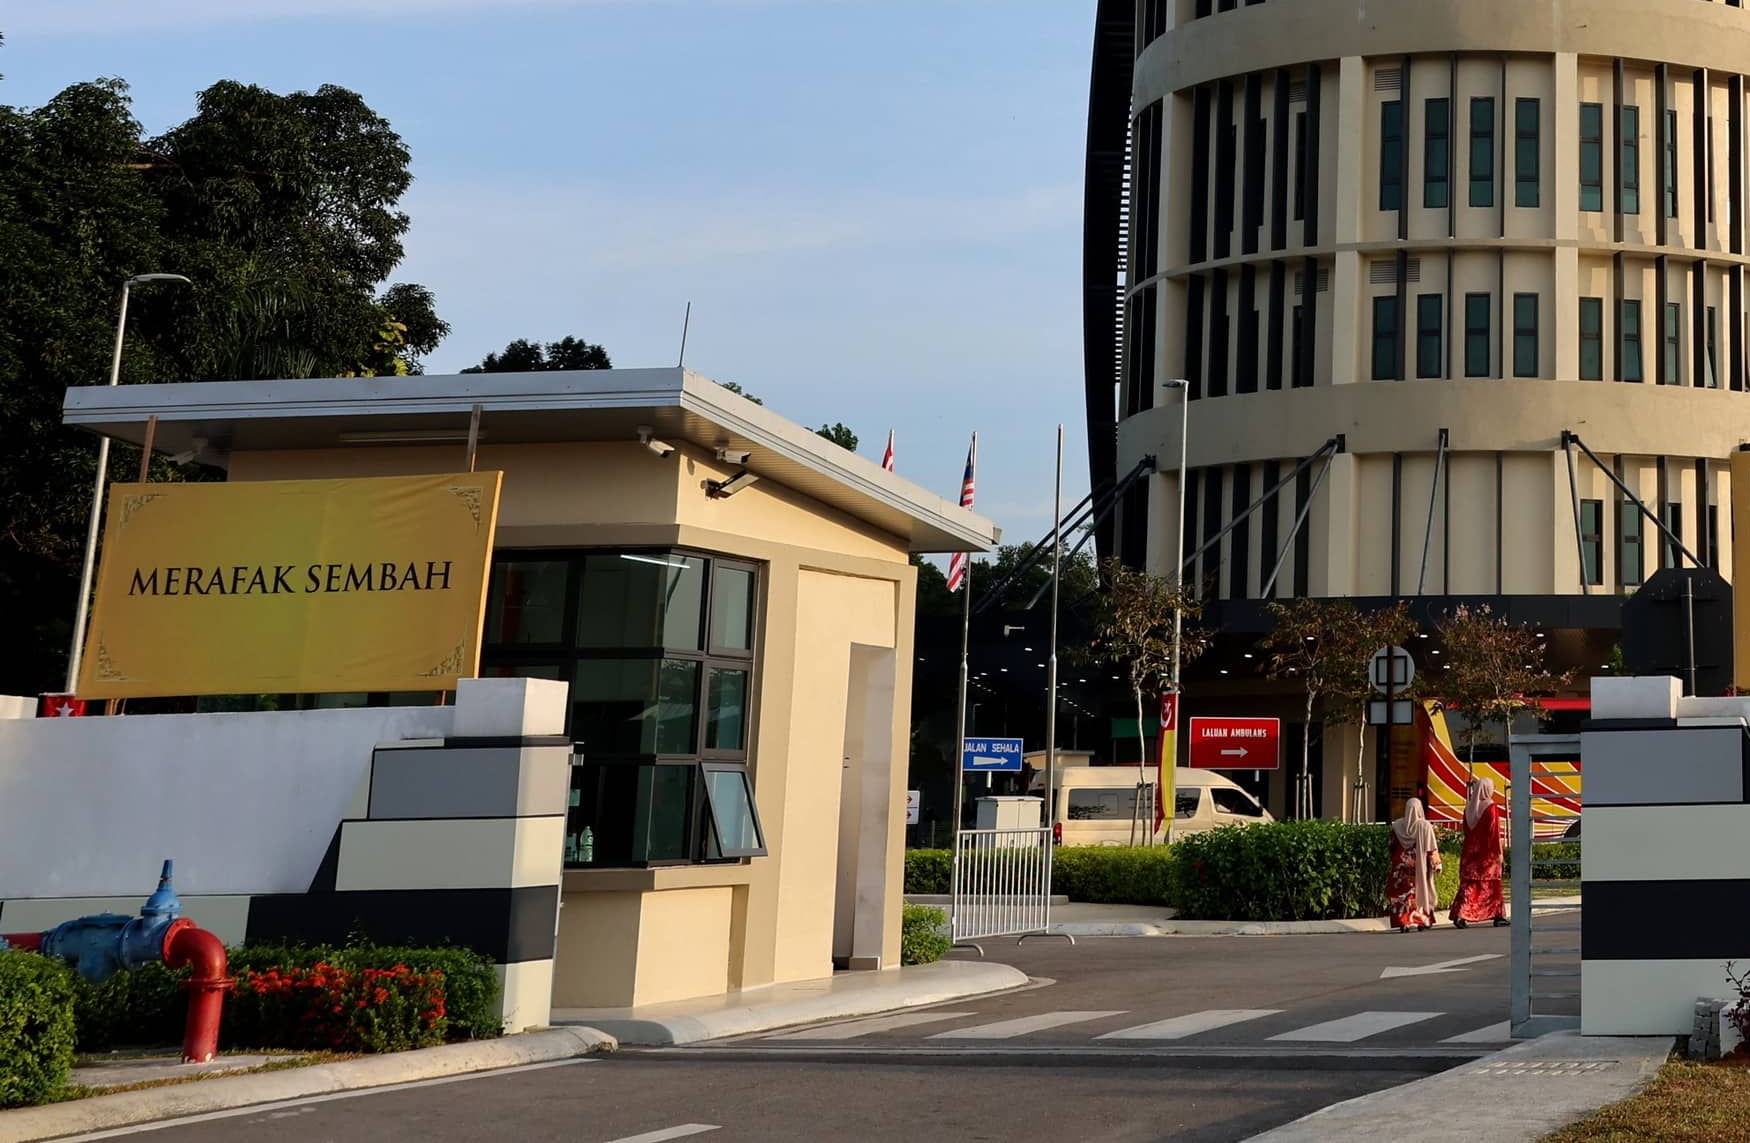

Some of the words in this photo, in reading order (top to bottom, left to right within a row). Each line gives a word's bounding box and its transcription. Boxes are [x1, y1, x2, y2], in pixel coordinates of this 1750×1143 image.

[128, 565, 297, 595] MERAFAK
[304, 561, 453, 593] SEMBAH
[1202, 728, 1228, 737] LALUAN
[1230, 728, 1267, 738] AMBULANS
[964, 743, 987, 753] JALAN
[991, 743, 1019, 753] SEHALA
